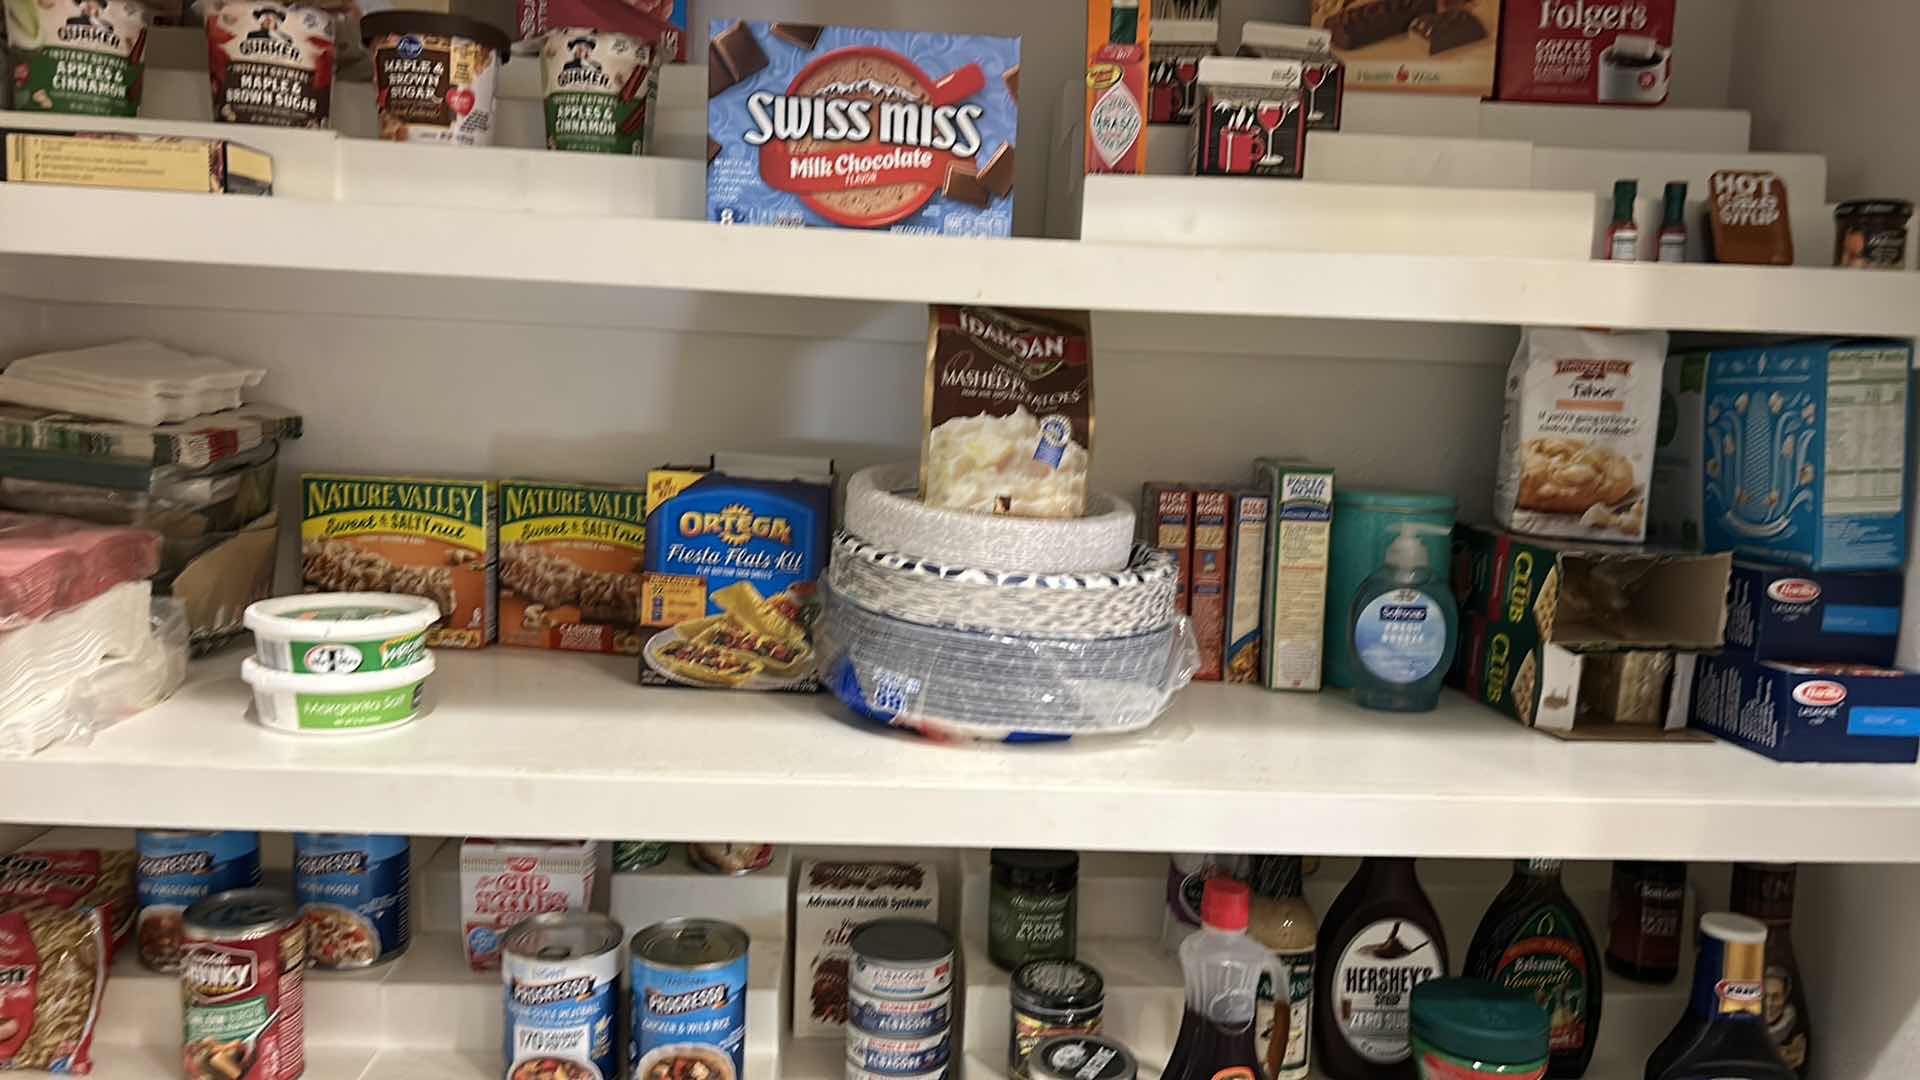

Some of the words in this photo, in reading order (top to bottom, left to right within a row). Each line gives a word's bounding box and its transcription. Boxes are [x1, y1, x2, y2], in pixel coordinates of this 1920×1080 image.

[57, 24, 121, 49] QUAKER
[239, 37, 305, 61] QUAKER
[55, 61, 114, 81] APPLES
[383, 57, 434, 75] MAPLE
[52, 77, 127, 98] CINNAMON
[241, 77, 289, 95] MAPLE
[557, 69, 611, 89] QUAKER
[226, 87, 273, 106] BROWN
[275, 94, 319, 114] SUGAR
[556, 103, 602, 121] APPLES
[554, 118, 617, 135] CINNAMON
[743, 91, 874, 145] SWISS
[790, 155, 834, 179] Milk
[834, 147, 934, 175] Chocolate
[1715, 173, 1779, 196] HOT
[307, 480, 396, 517] NATURE
[396, 481, 479, 523] VALLEY
[505, 487, 584, 522] NATURE
[389, 513, 431, 534] SALTY
[427, 518, 466, 540] nut
[581, 522, 619, 538] SALTY
[679, 511, 792, 545] ORTEGA
[666, 544, 722, 567] Fiesta
[724, 548, 772, 569] Flats
[774, 551, 804, 571] Kit
[806, 895, 855, 909] Advanced
[855, 895, 888, 909] Health
[889, 898, 932, 912] Systems
[513, 977, 593, 1006] PROGRESSO
[1345, 966, 1434, 994] HERSHEY'S
[648, 986, 727, 1016] PROGRESSO
